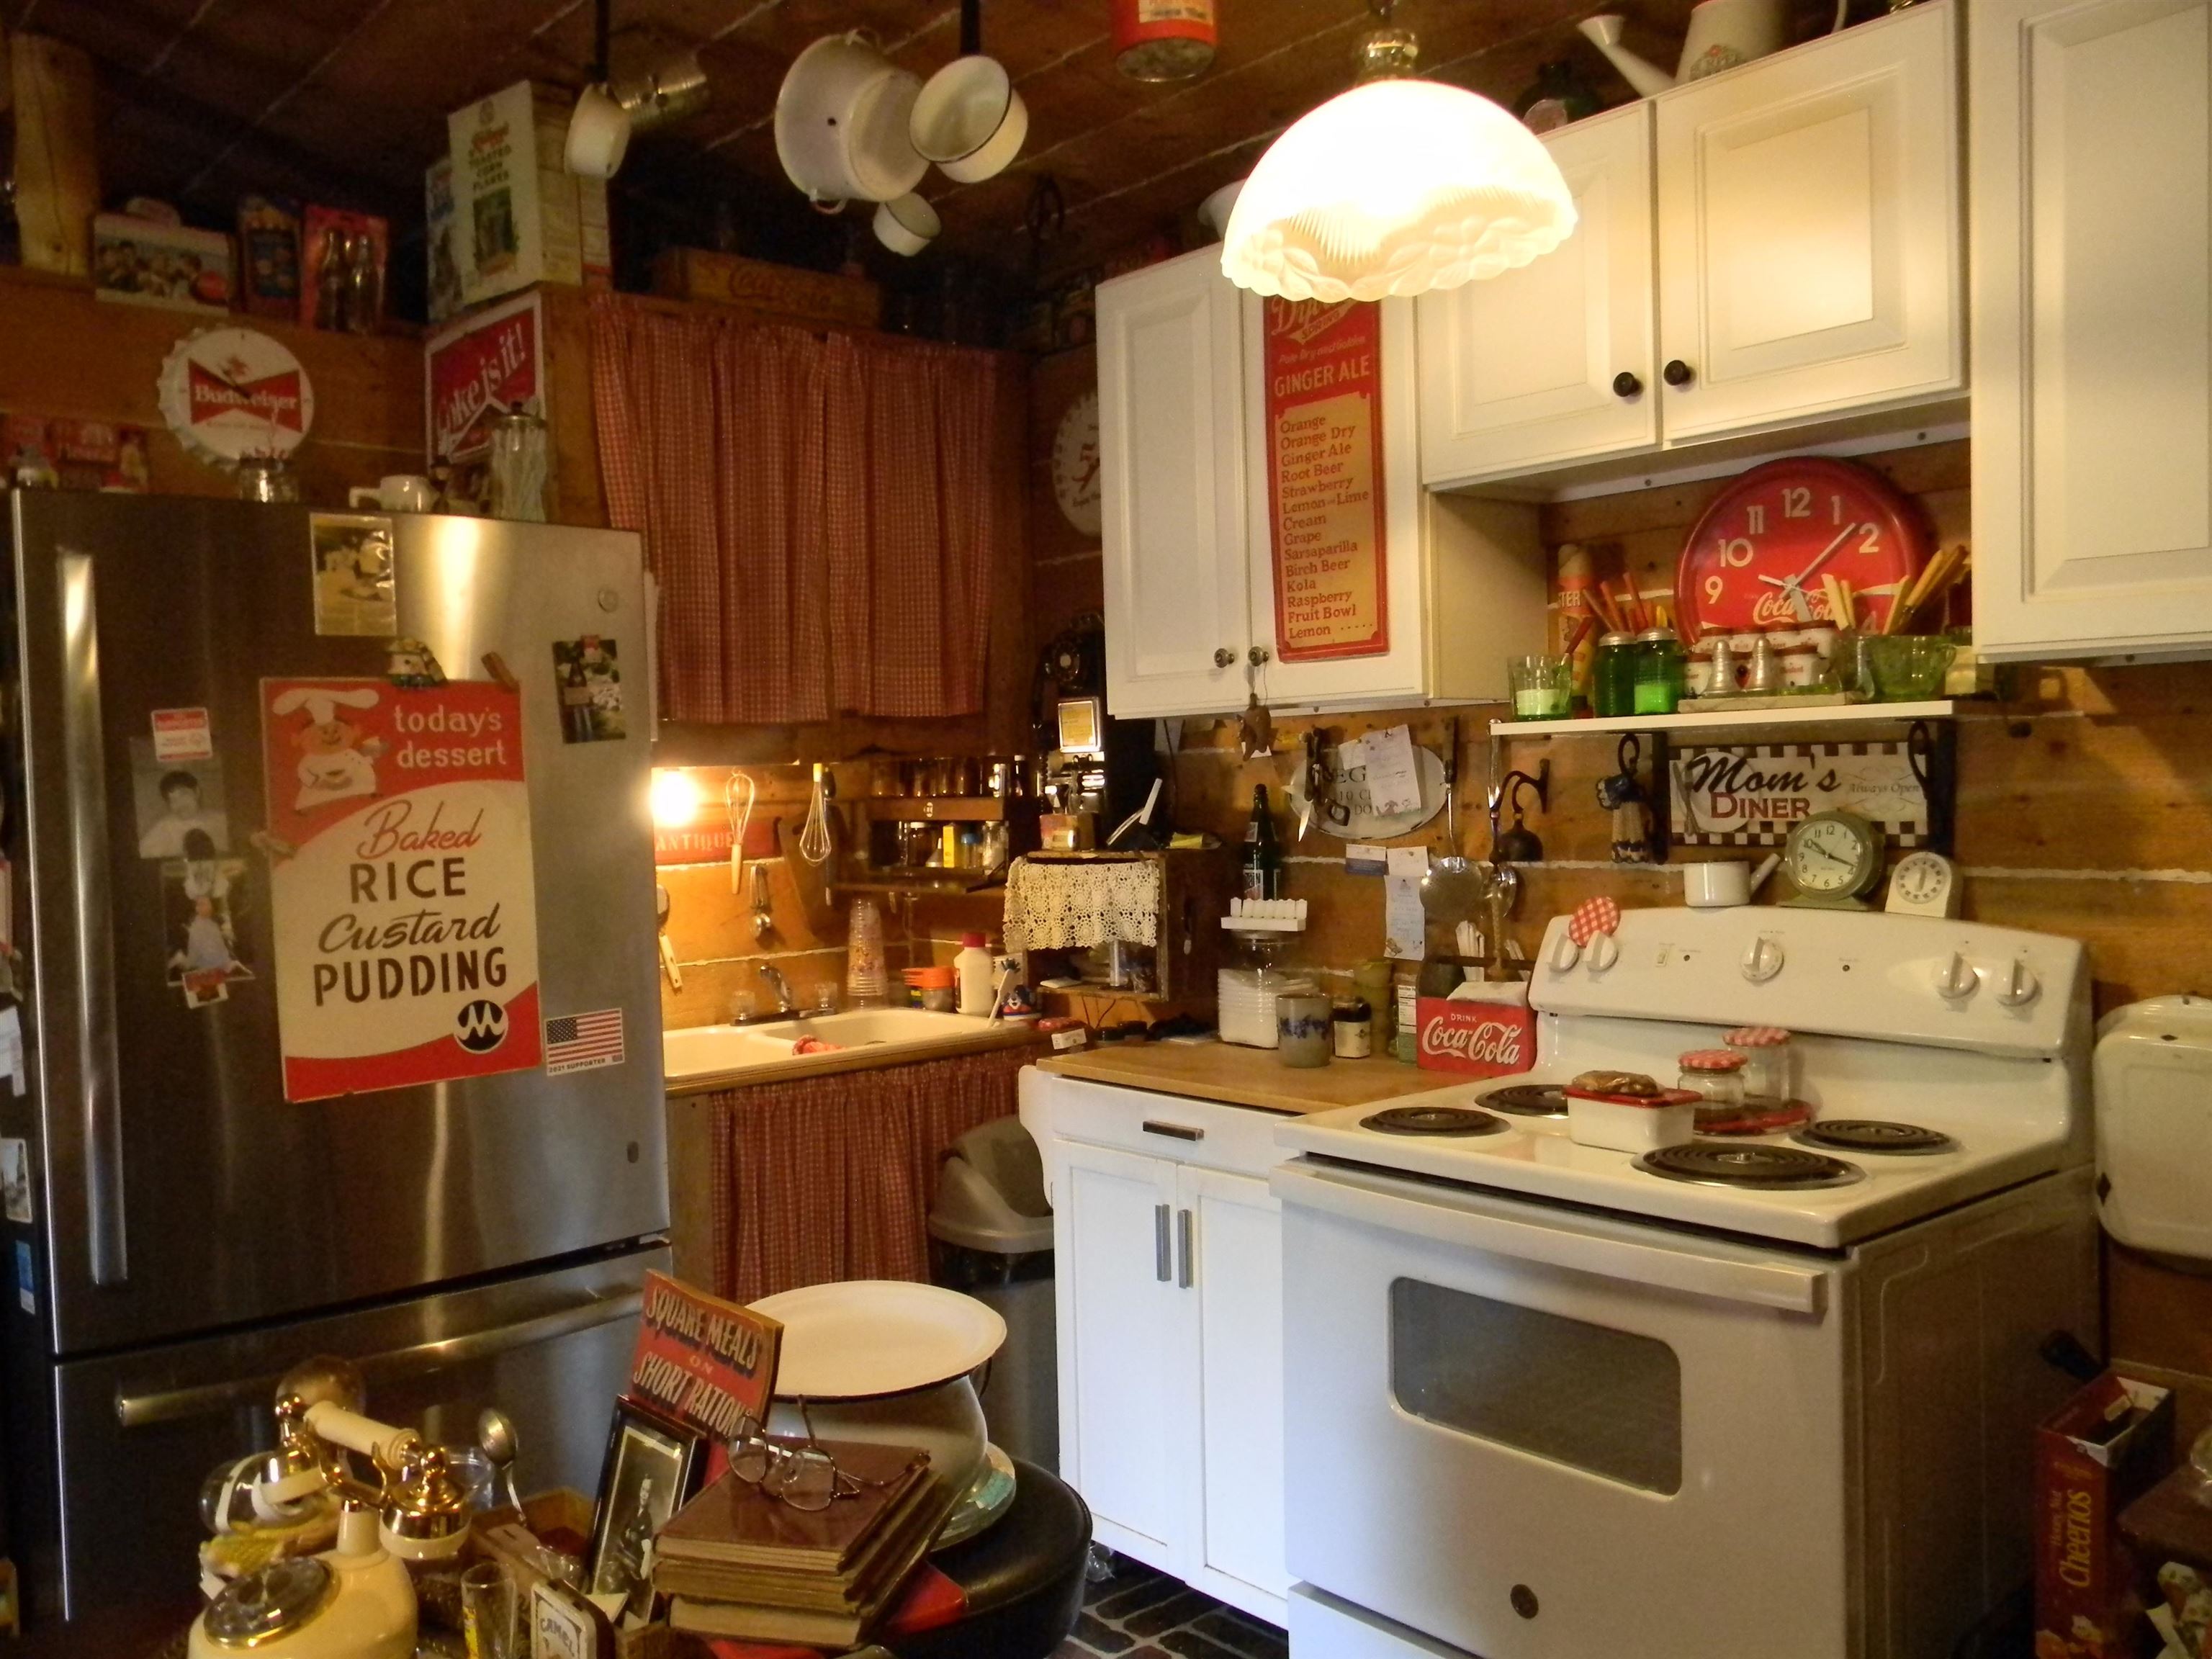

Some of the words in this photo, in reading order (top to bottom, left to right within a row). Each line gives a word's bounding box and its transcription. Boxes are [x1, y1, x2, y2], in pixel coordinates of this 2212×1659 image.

[480, 356, 503, 396] is
[499, 322, 526, 378] it!
[1274, 364, 1334, 397] GINGER
[1339, 354, 1371, 382] ALE
[1280, 415, 1326, 433] Orange
[1280, 432, 1326, 450] Orange
[1331, 426, 1356, 440] Dry
[1282, 449, 1326, 467] Ginger
[1328, 442, 1352, 457] Ale
[1281, 468, 1310, 483] Root
[1313, 462, 1344, 477] Beer
[1282, 477, 1354, 499] Strawberry
[1782, 487, 1811, 518] 12
[1831, 495, 1841, 525] 1
[1283, 514, 1326, 531] Cream
[1746, 505, 1763, 535] 11
[1283, 531, 1321, 546] Grape
[1858, 523, 1880, 554] 2
[1284, 541, 1358, 561] Sarsaparilla
[1717, 538, 1754, 567] 10
[1285, 562, 1318, 577] Birch
[1321, 559, 1351, 573] Beer
[1287, 579, 1316, 593] Kola
[1704, 576, 1723, 605] 9
[1287, 590, 1352, 608] Raspberry
[1558, 590, 1581, 607] TER
[1288, 608, 1320, 624] Fruit
[1323, 603, 1357, 619] Bowl
[1289, 625, 1331, 639] Lemon
[394, 704, 502, 738] today's
[397, 739, 506, 768] dessert
[1685, 752, 1844, 793] Mom's
[1340, 790, 1354, 801] 10
[1709, 792, 1811, 819] DINER
[356, 799, 484, 860] Baked
[1814, 829, 1821, 839] 11
[1826, 825, 1835, 835] 12
[1843, 830, 1847, 840] 1
[1803, 838, 1813, 849] 10
[1851, 840, 1858, 850] 2
[1802, 864, 1807, 873] 8
[1812, 873, 1817, 883] 7
[1848, 866, 1854, 876] 4
[350, 857, 466, 904] RICE
[1824, 878, 1830, 888] 6
[1838, 875, 1843, 885] 5
[318, 902, 500, 954] Custard
[313, 947, 507, 1007] PUDDING
[1450, 1013, 1478, 1023] DRINK
[1422, 1016, 1522, 1065] Coca-Cola
[567, 1058, 606, 1069] SUPPORTER
[646, 1285, 708, 1343] SQUARE
[706, 1313, 762, 1370] MEALS
[689, 1354, 714, 1375] ON
[633, 1351, 693, 1404] SHORT
[2058, 1488, 2092, 1588] Cheerios
[540, 1617, 575, 1657] CAMEL
